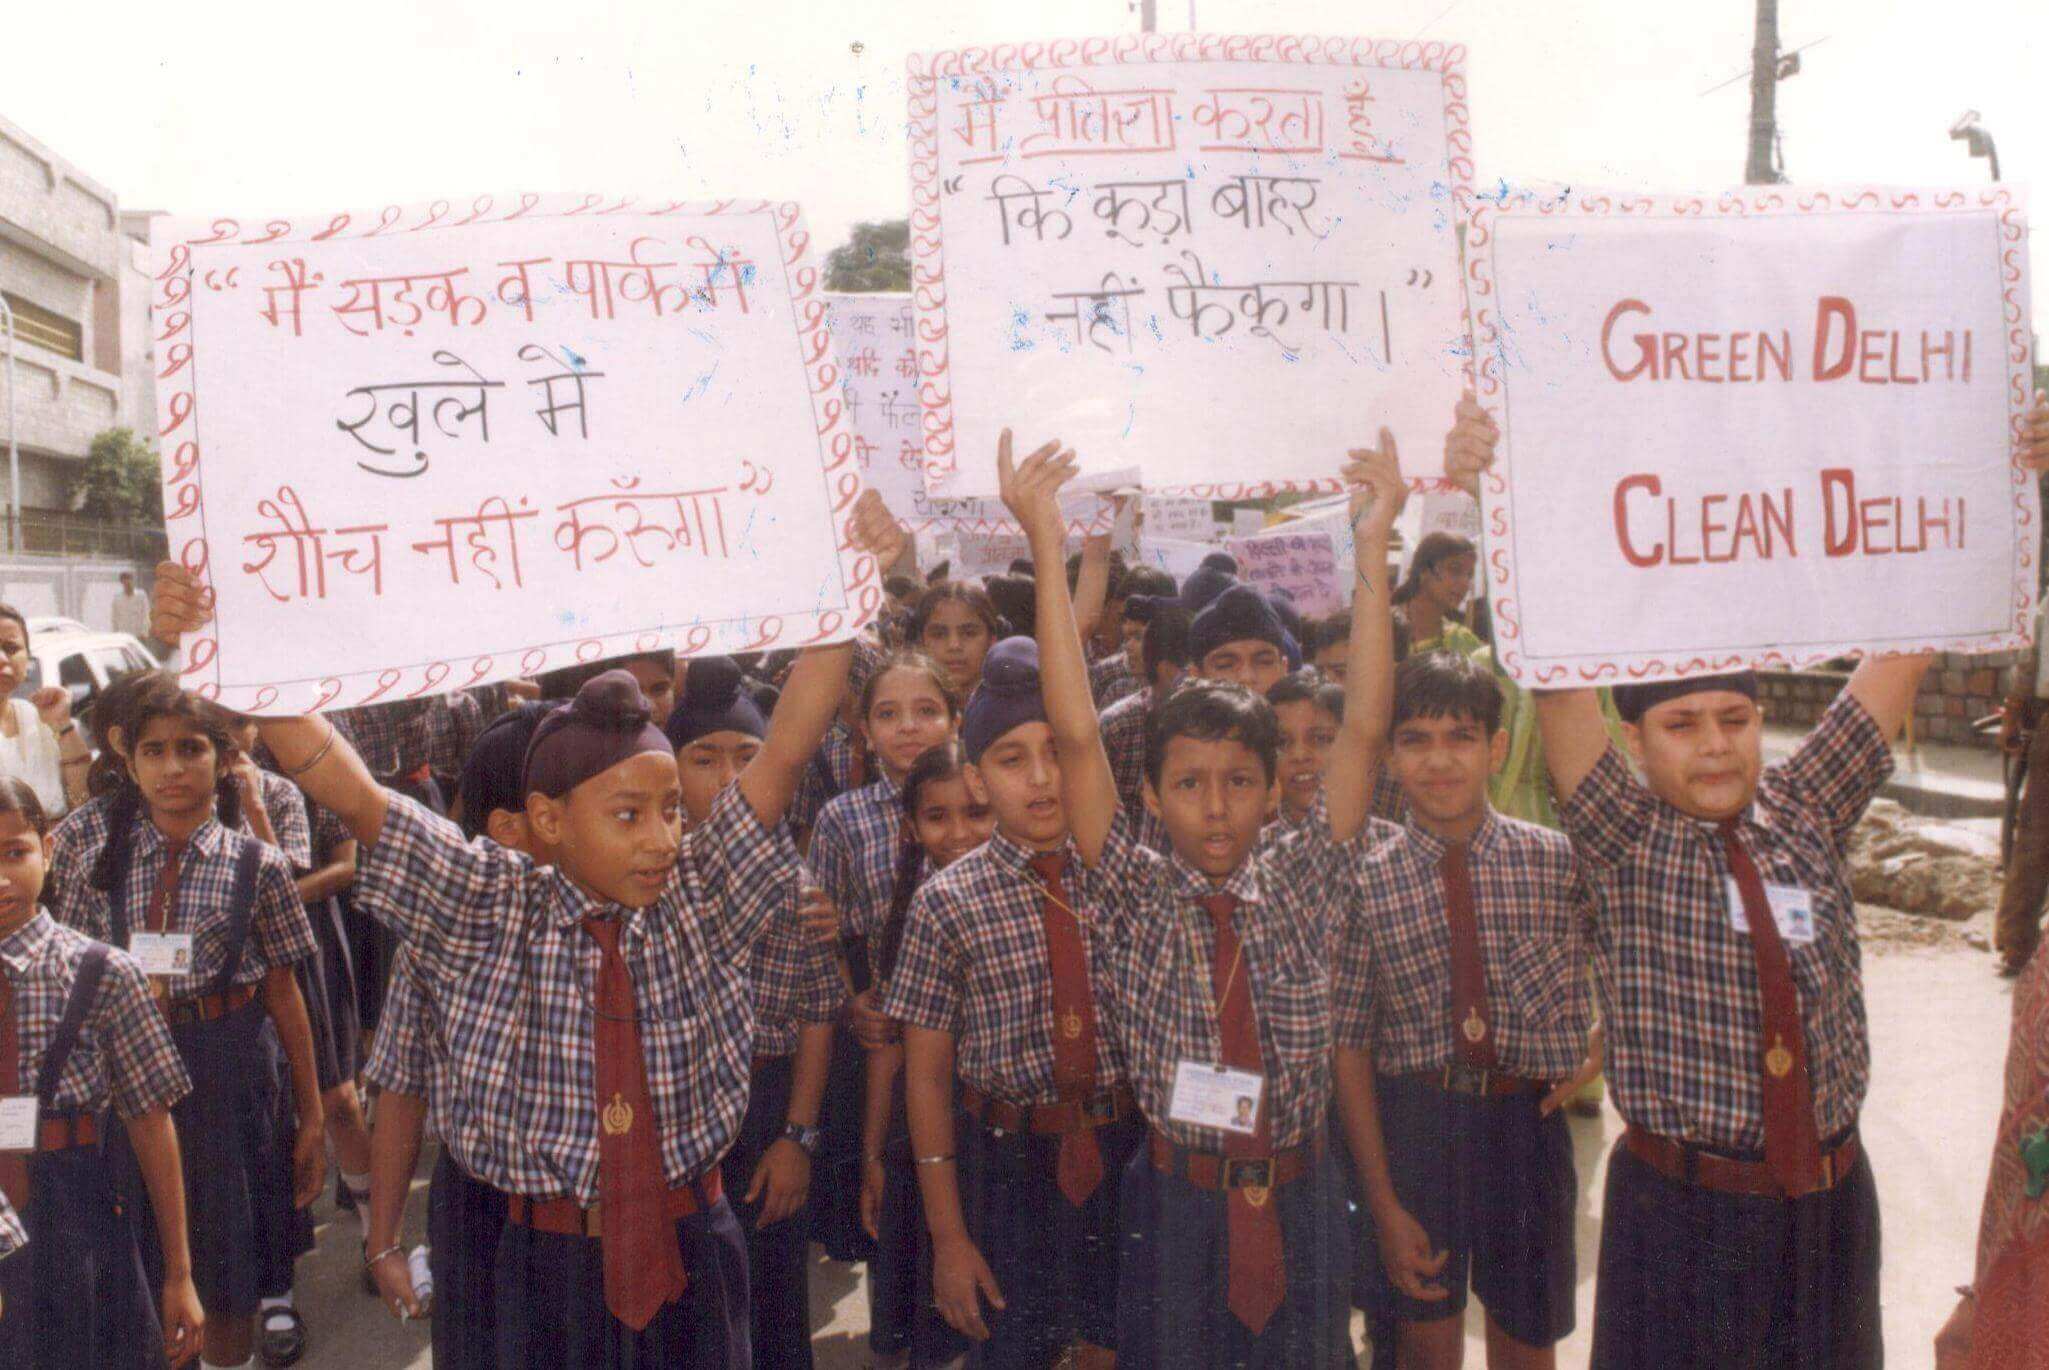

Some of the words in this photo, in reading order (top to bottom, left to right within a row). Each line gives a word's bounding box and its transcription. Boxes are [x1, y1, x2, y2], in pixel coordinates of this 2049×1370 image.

[1192, 87, 1323, 150] करता
[1093, 179, 1193, 248] कूड़ा
[1212, 174, 1327, 240] बाहर
[331, 266, 487, 337] सड़क
[496, 256, 553, 323] व
[565, 236, 690, 320] पार्क
[1600, 297, 1793, 383] GREEN
[1813, 295, 1972, 384] DELHI
[336, 349, 506, 479] खुले
[242, 485, 388, 602] शौच
[411, 495, 539, 590] नहीं
[1613, 473, 1798, 568] CLEAN
[1820, 468, 1966, 558] DELHI
